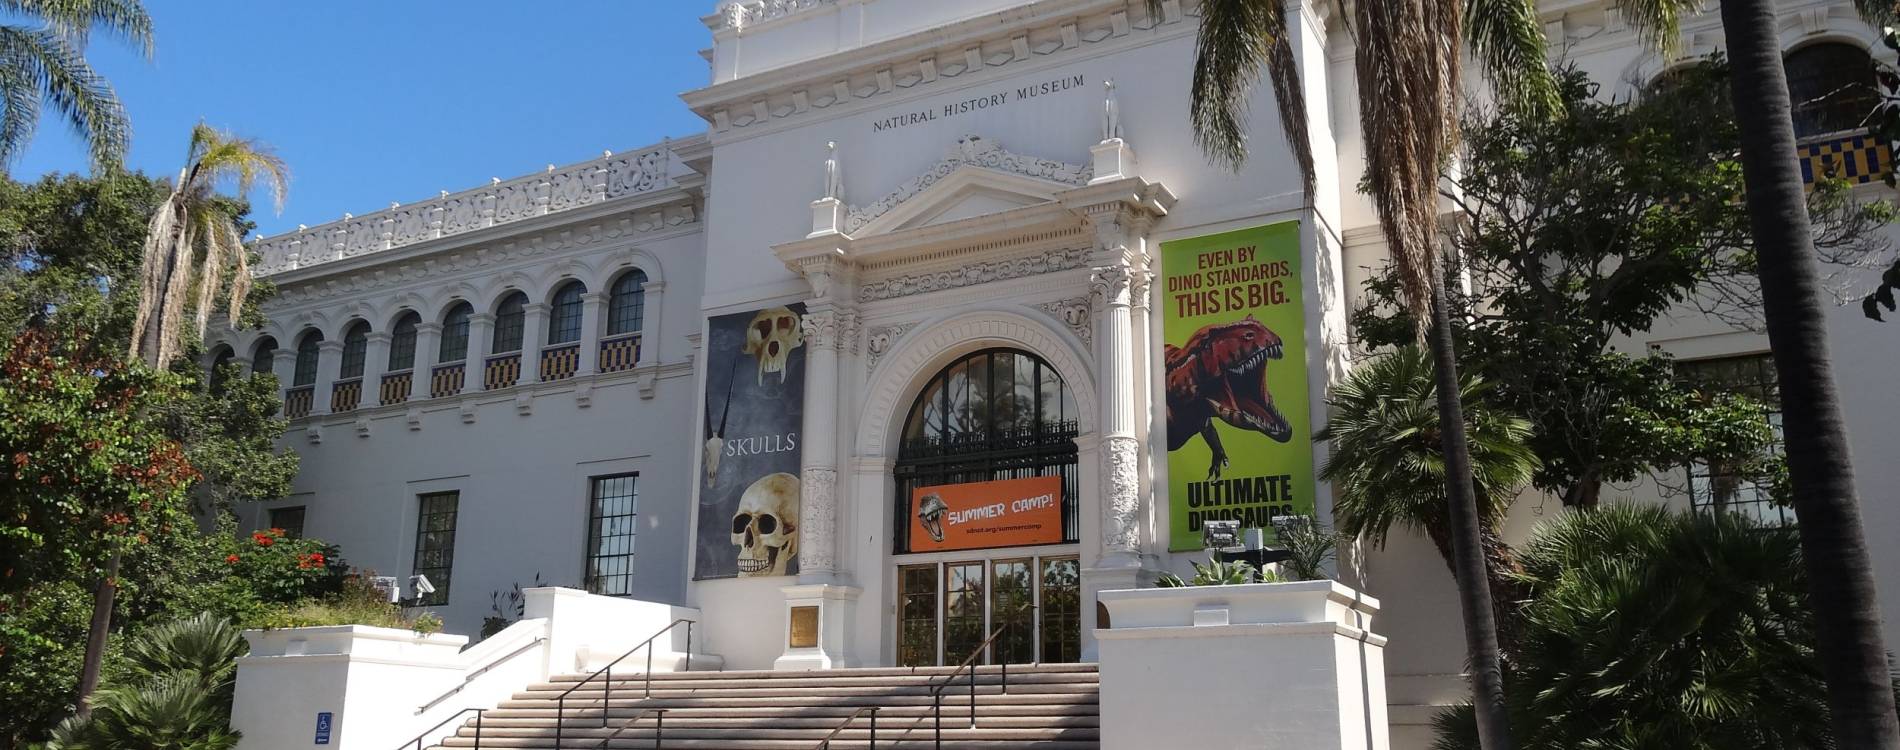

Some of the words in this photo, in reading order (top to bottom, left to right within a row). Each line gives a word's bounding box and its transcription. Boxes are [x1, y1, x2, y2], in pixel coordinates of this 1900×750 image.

[873, 109, 937, 132] NATURAL
[944, 92, 1008, 117] HISTORY
[1016, 74, 1084, 101] MUSEUM
[1198, 249, 1233, 270] EVEN
[1237, 245, 1257, 263] BY
[1168, 273, 1202, 292] DINO
[1206, 260, 1293, 287] STANDARDS,
[1175, 289, 1221, 318] THIS
[1224, 286, 1245, 312] IS
[1247, 280, 1290, 308] BIG.
[726, 432, 796, 457] SKULLS
[1187, 474, 1293, 508] ULTIMATE
[948, 503, 1006, 526] SUMMER
[1011, 493, 1054, 514] CAMP!
